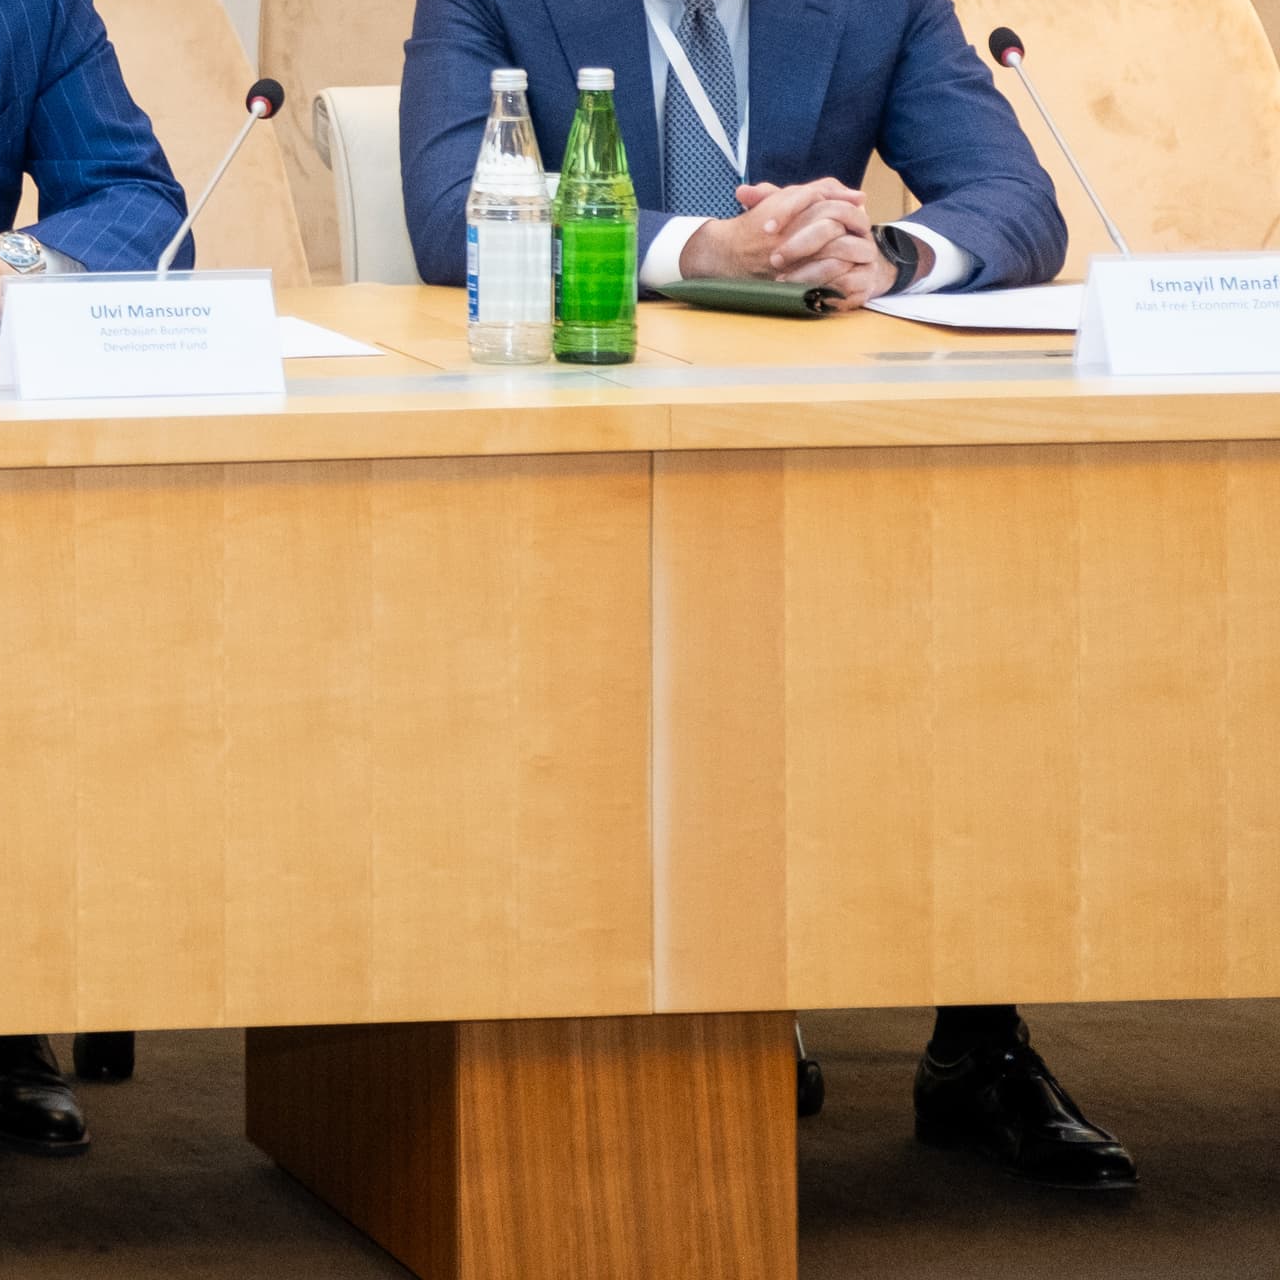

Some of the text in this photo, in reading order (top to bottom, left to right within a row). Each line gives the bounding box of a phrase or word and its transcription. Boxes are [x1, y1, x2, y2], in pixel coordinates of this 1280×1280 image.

[1149, 274, 1280, 295] Ismayil Manaf
[89, 304, 212, 319] Ulvi Mansurov
[103, 341, 177, 353] Development
